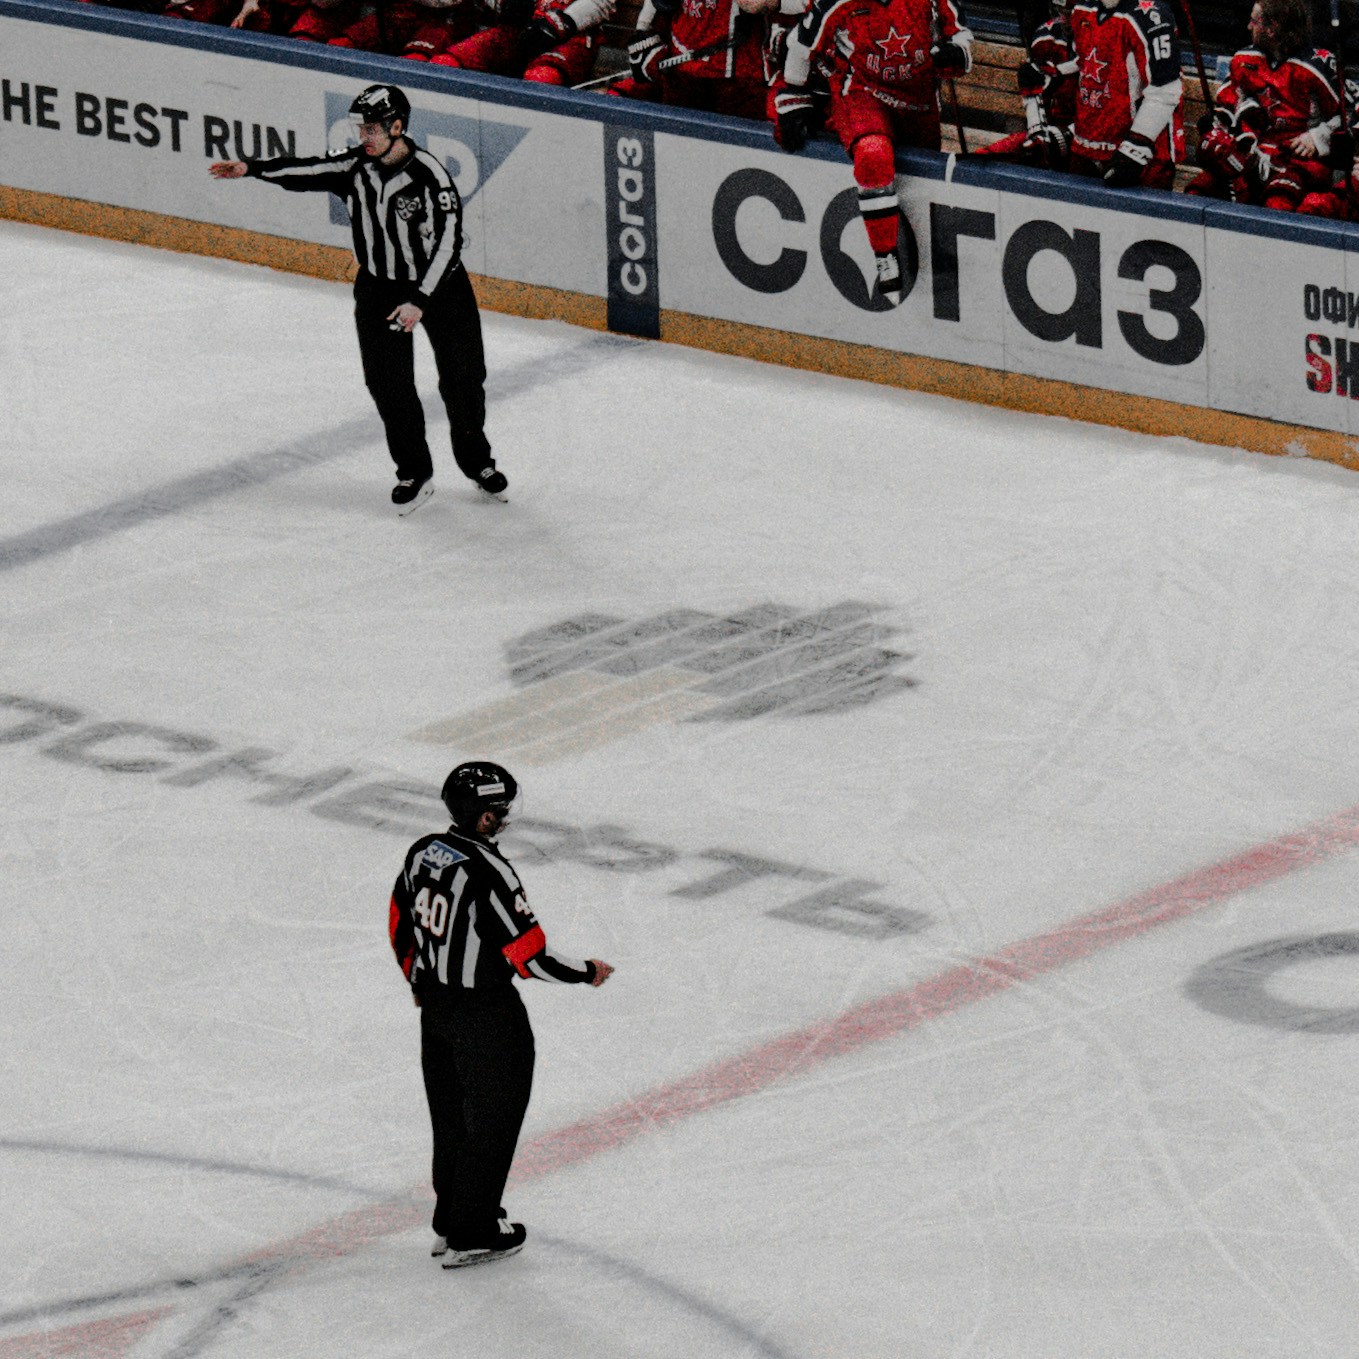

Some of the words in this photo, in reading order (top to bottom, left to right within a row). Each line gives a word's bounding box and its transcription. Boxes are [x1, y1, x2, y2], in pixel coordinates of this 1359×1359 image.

[1152, 33, 1172, 61] 15
[75, 92, 188, 152] BEST
[203, 114, 296, 162] RUN
[413, 885, 449, 938] 40
